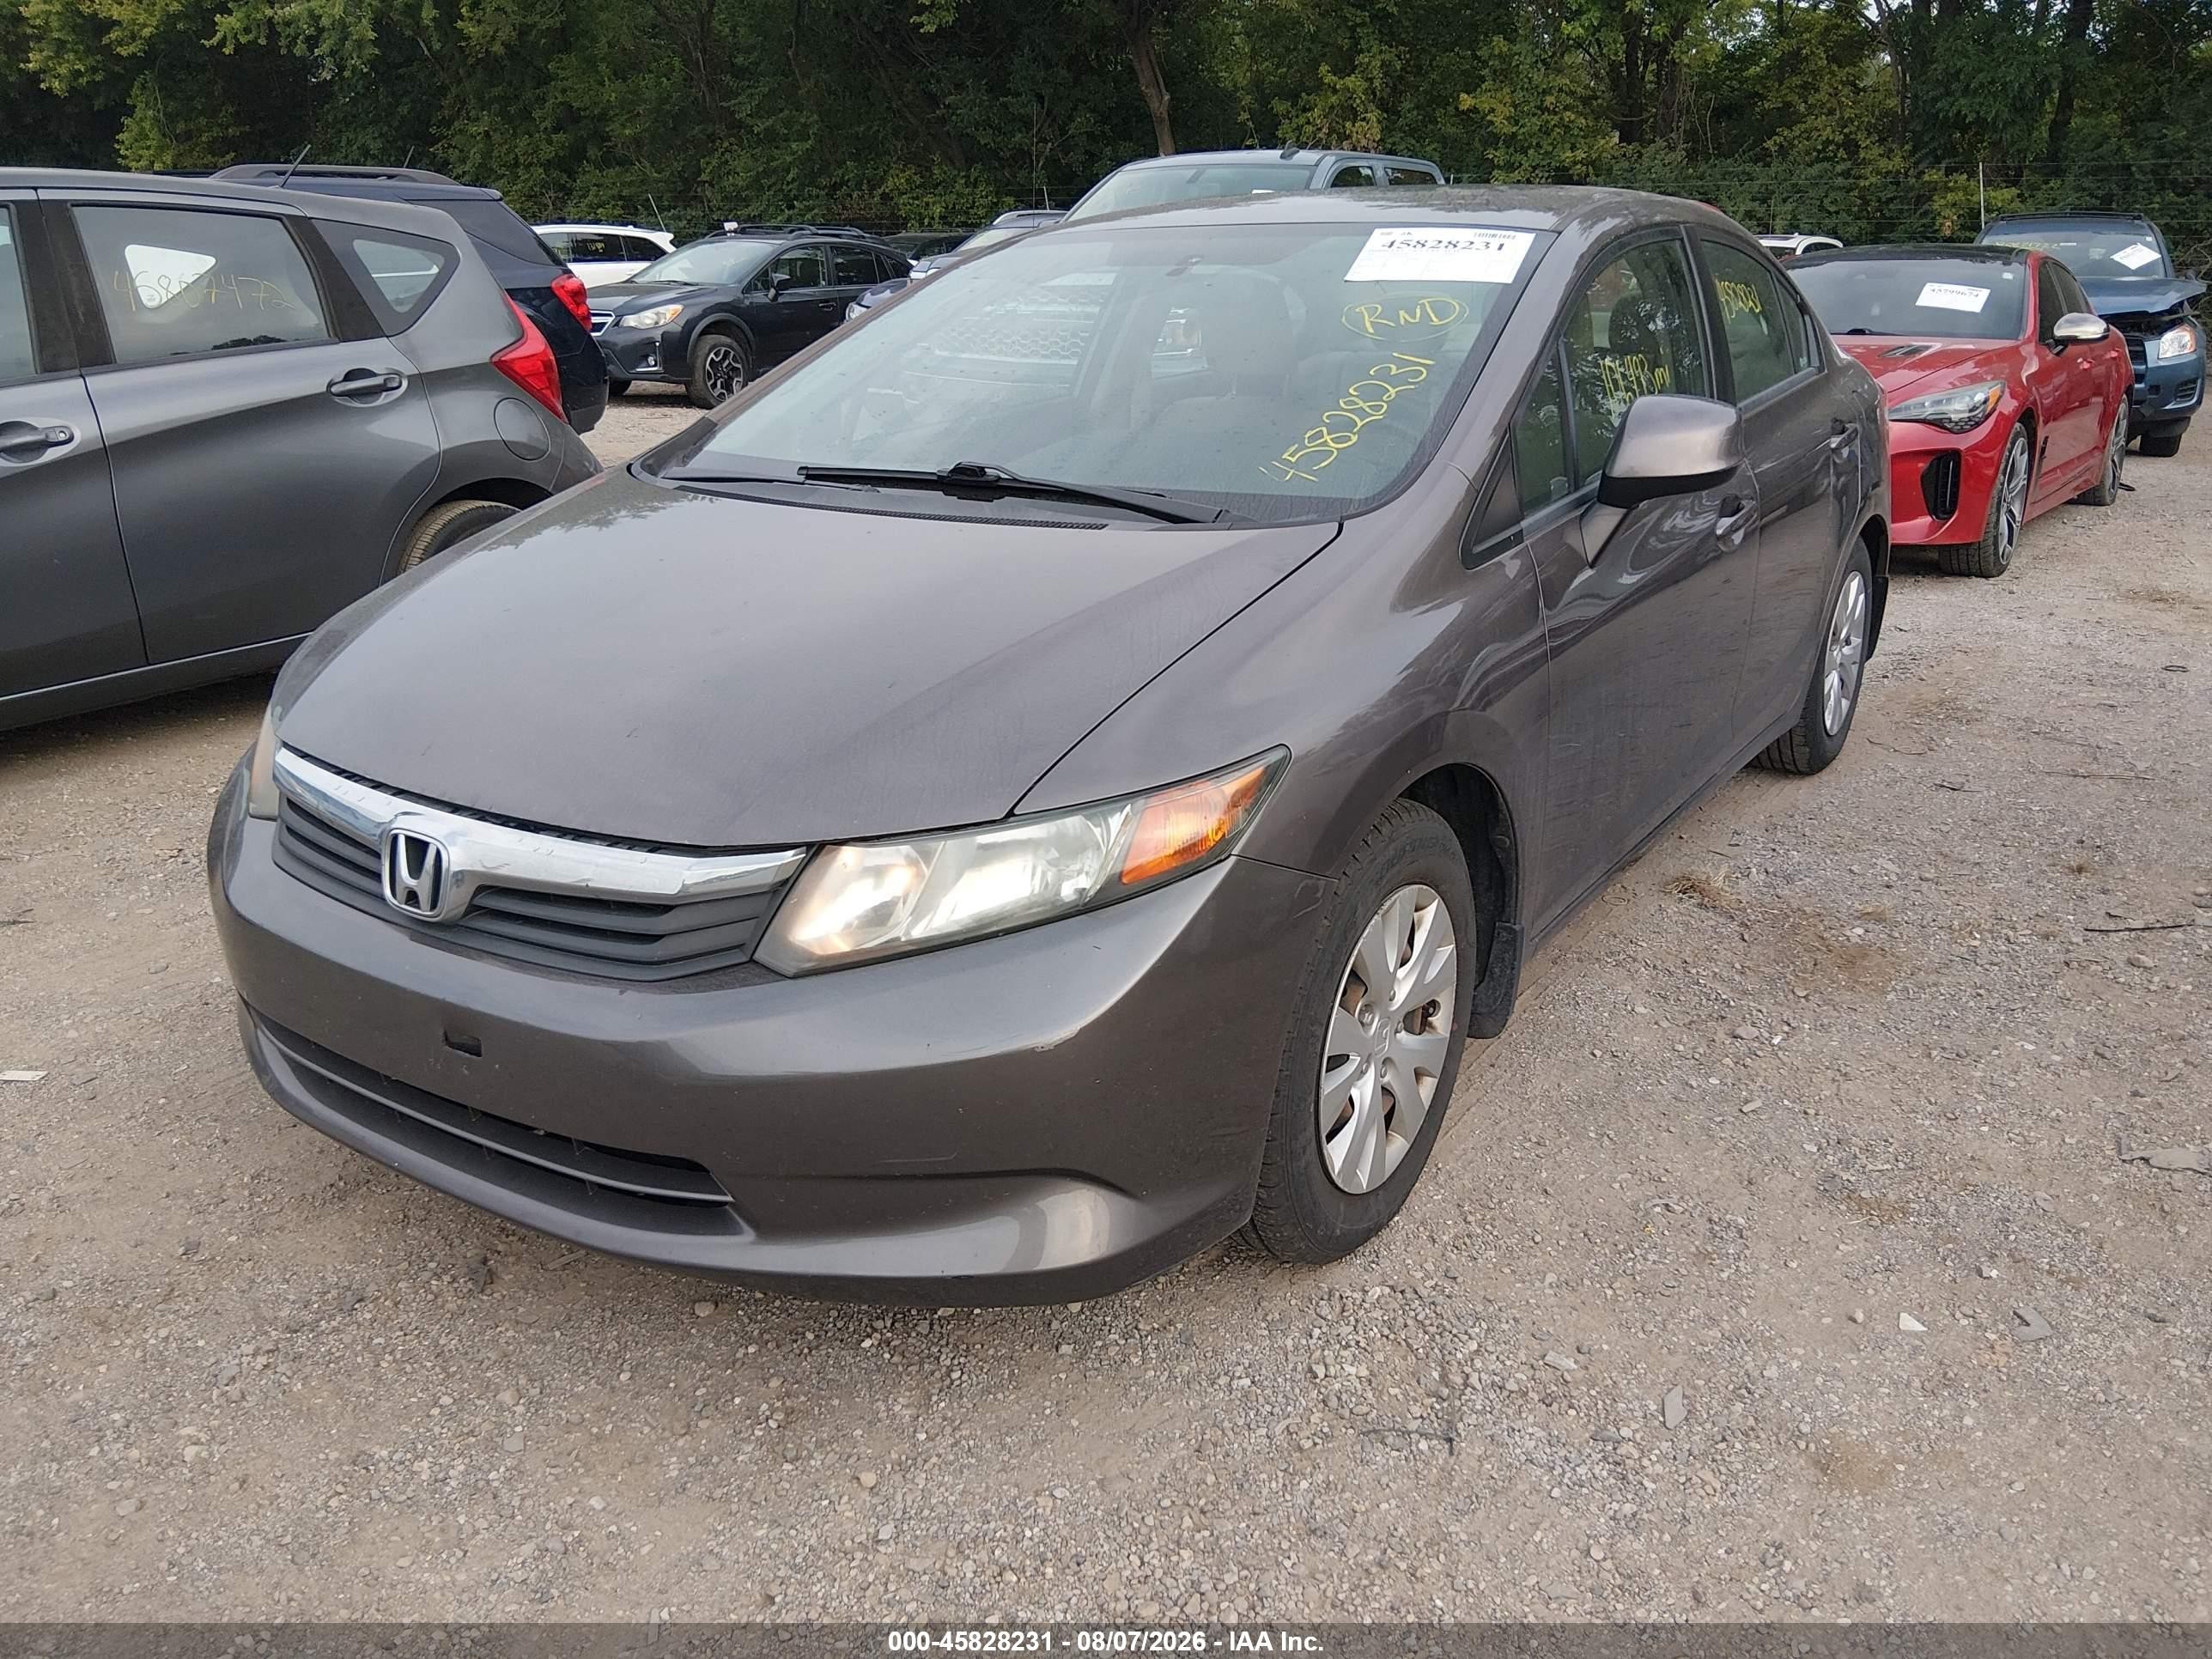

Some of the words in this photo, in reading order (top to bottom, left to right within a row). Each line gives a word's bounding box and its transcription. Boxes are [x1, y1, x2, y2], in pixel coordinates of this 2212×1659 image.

[1381, 239, 1505, 252] 45828231
[1355, 298, 1459, 333] RND
[1257, 351, 1437, 482] 45828231
